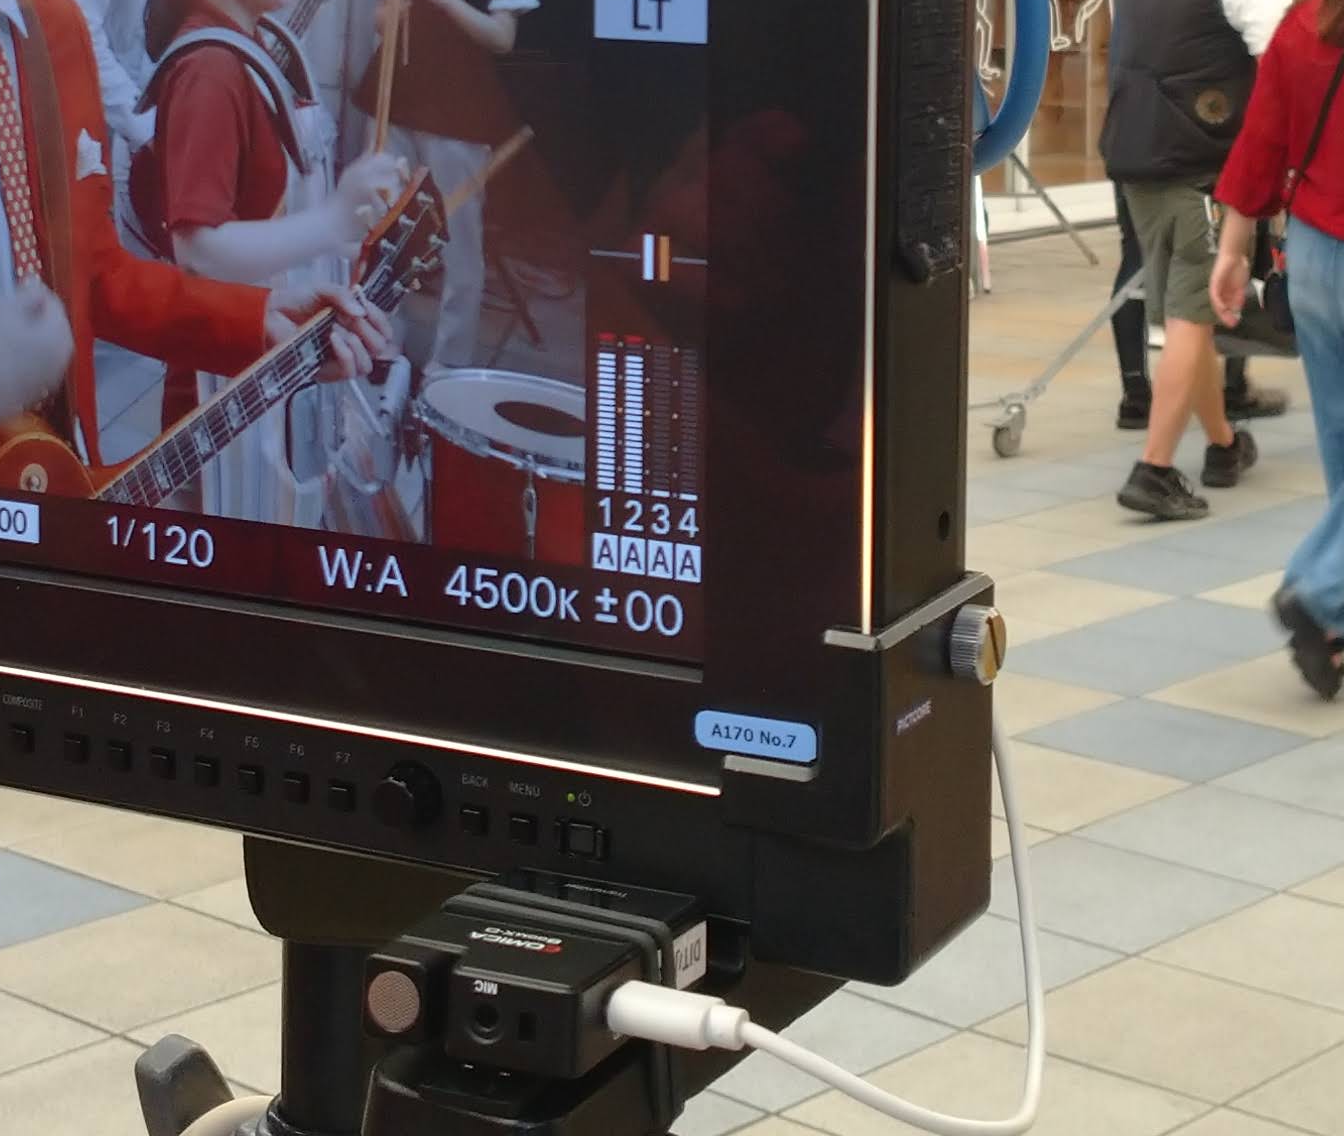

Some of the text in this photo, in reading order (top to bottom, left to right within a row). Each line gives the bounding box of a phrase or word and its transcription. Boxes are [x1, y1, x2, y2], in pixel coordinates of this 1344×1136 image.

[106, 514, 216, 569] 1/120
[318, 544, 410, 599] W:A
[444, 564, 582, 623] 4500K
[594, 586, 684, 637] ±00
[711, 723, 798, 750] A170 No.7
[509, 780, 542, 799] MENU
[473, 979, 499, 995] MIC
